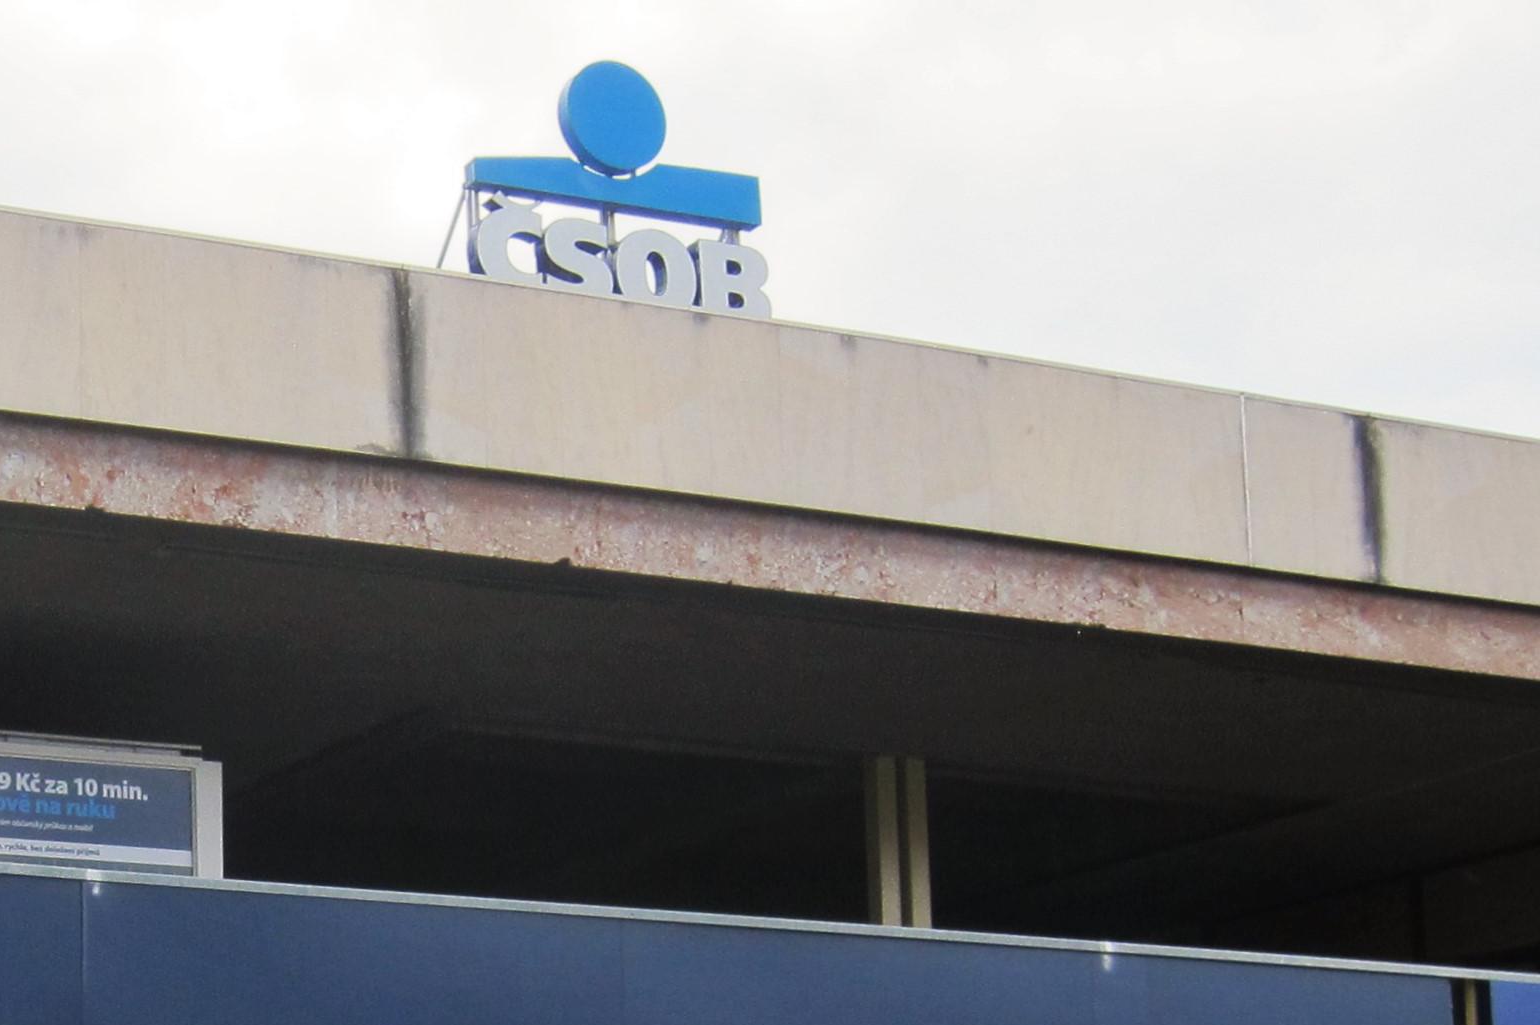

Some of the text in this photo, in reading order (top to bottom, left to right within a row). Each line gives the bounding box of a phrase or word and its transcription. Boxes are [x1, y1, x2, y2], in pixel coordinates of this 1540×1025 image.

[468, 190, 772, 320] ČSOB
[16, 772, 41, 793] Kč
[44, 780, 68, 795] za
[74, 778, 98, 797] 10
[102, 780, 148, 801] min.
[35, 800, 61, 815] na
[66, 799, 117, 819] ruku
